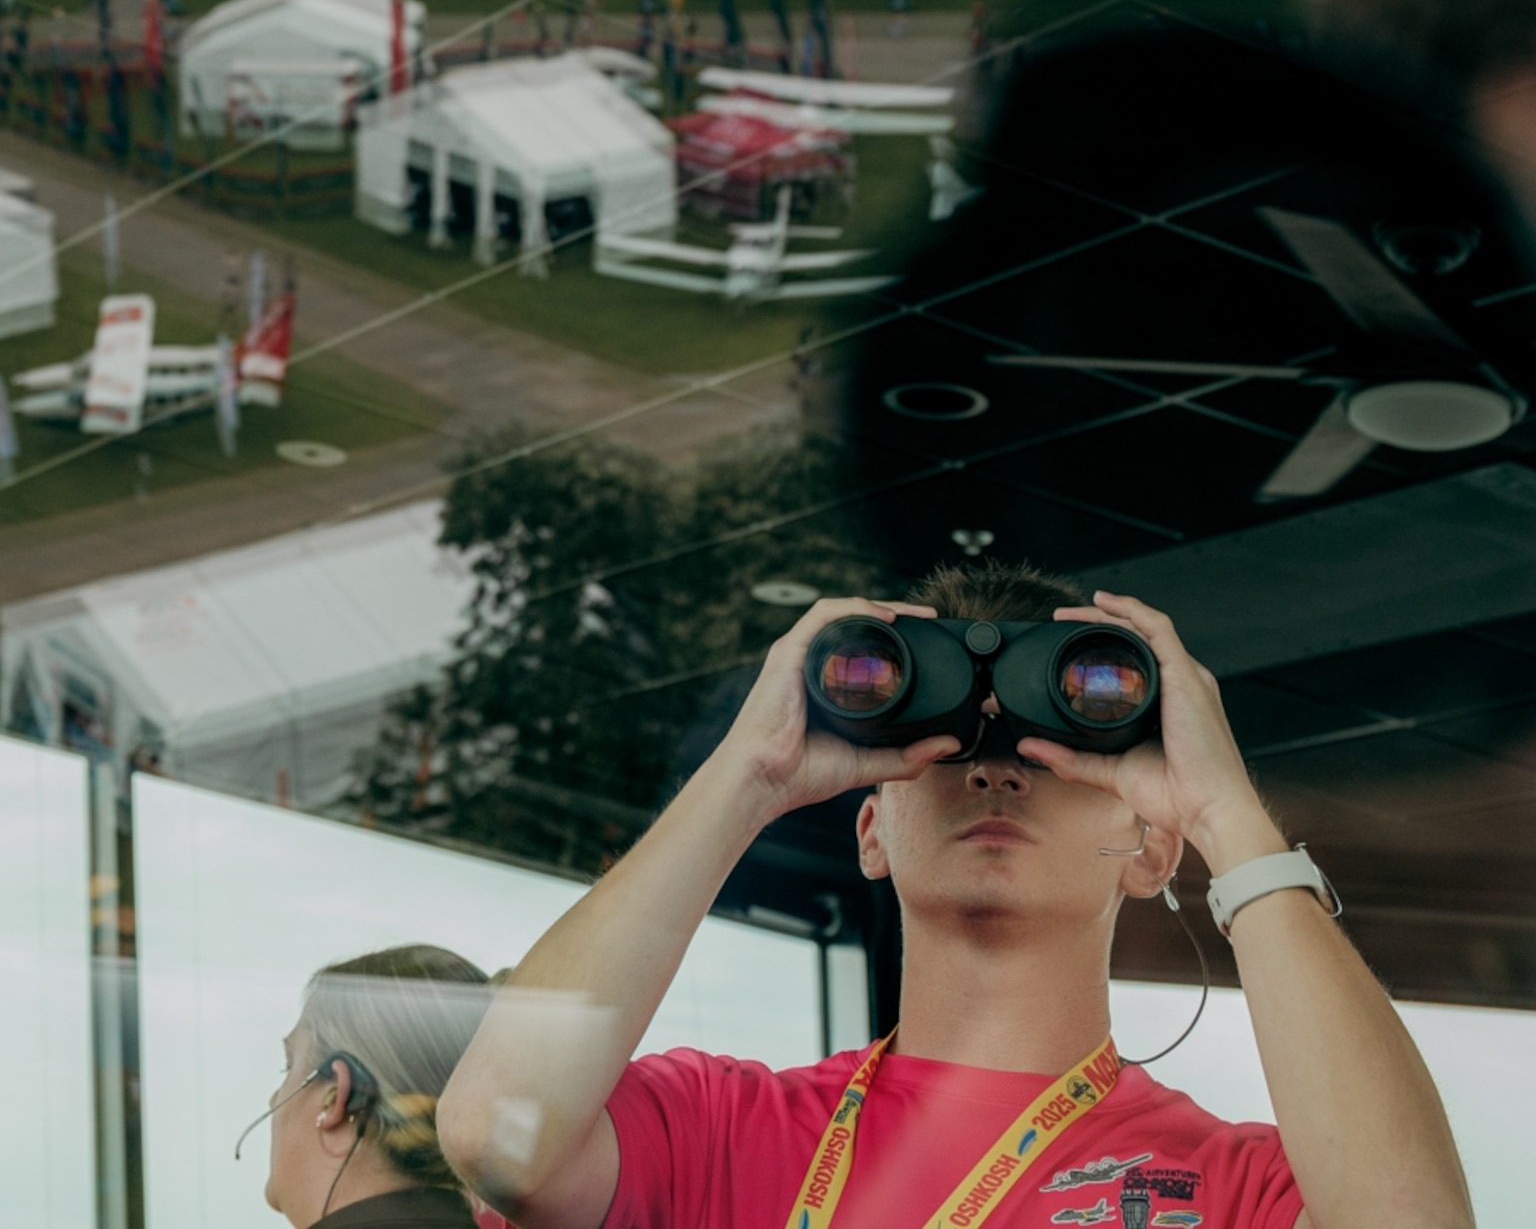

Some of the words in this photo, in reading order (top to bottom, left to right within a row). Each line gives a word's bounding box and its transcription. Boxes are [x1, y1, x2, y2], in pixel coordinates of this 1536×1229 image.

[804, 1126, 851, 1210] OSHKOSH
[949, 1154, 1021, 1228] OSHKOSH
[1032, 1093, 1077, 1132] 2025
